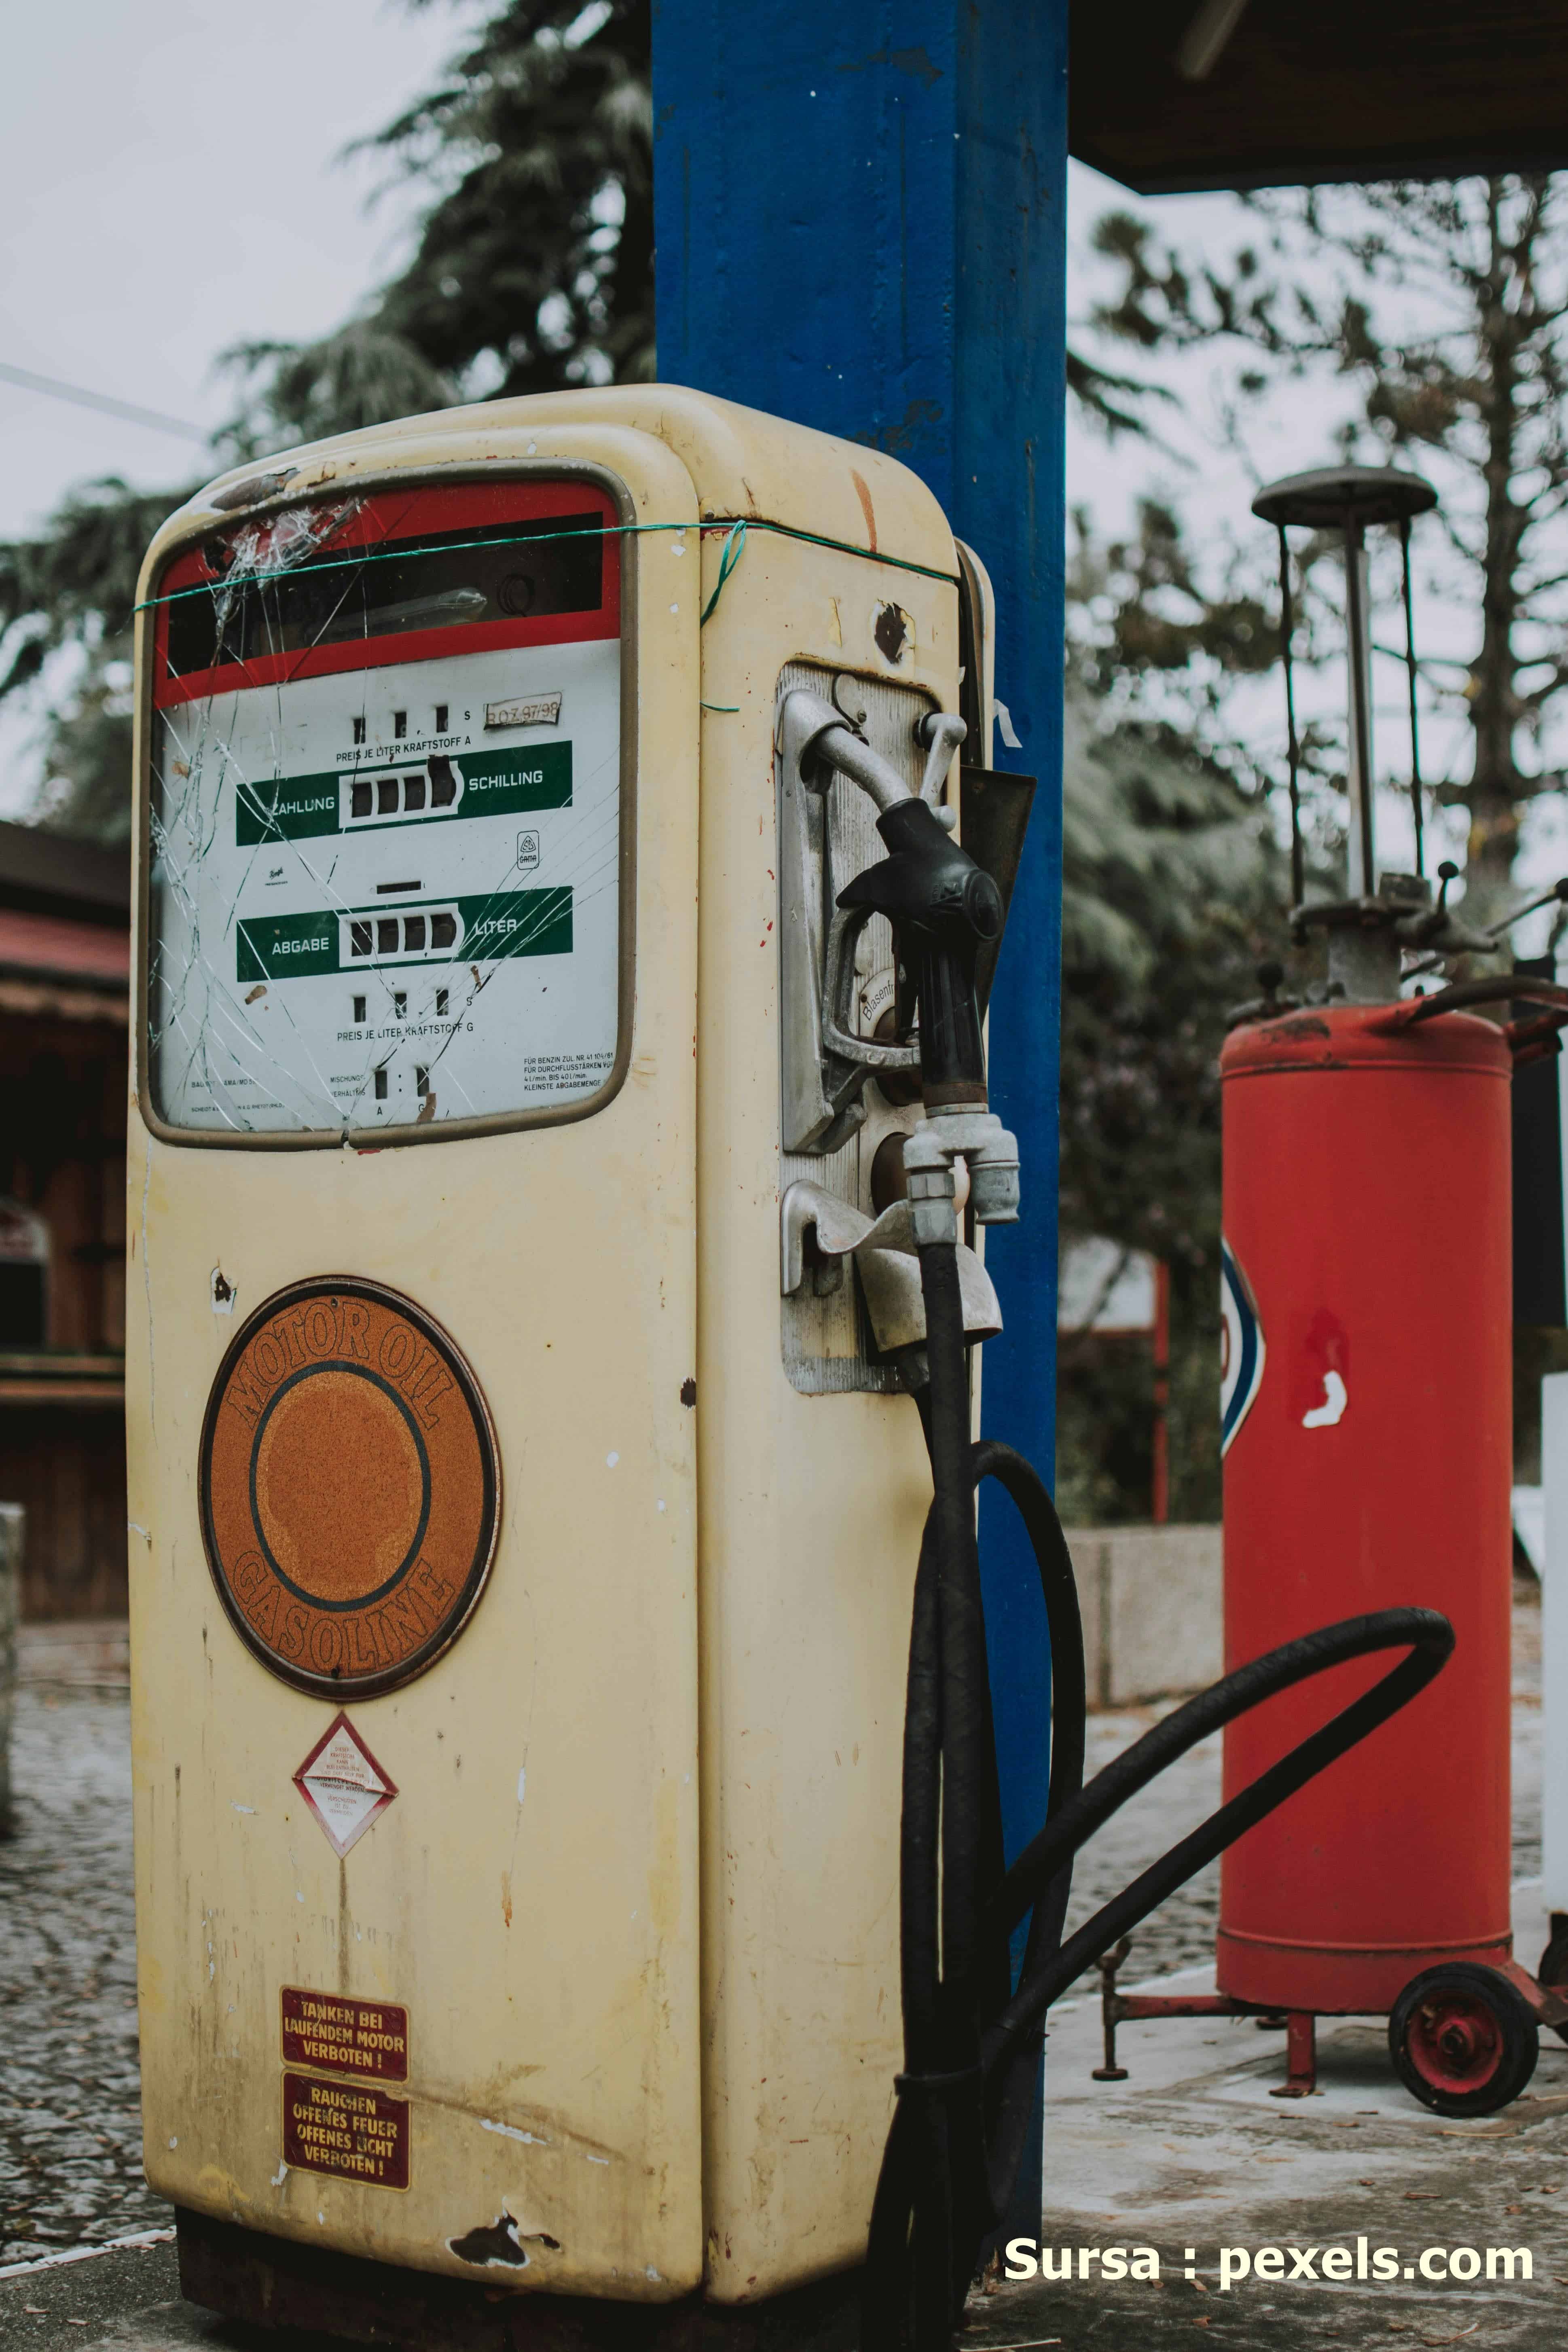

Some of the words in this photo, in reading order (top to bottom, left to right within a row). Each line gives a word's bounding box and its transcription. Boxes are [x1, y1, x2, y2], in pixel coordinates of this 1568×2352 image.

[523, 701, 558, 720] 97/98
[336, 751, 361, 762] PREIS
[364, 749, 373, 758] JE
[377, 745, 400, 756] LITER
[404, 737, 461, 753] KRAFTSTOFF
[465, 736, 471, 745] A
[469, 771, 543, 791] SCHILLING
[475, 919, 517, 935] LITER
[272, 938, 329, 955] ABGABE
[337, 1031, 362, 1042] PREIS
[365, 1030, 374, 1039] JE
[405, 1023, 463, 1036] KRAFTSTOFF
[467, 1023, 473, 1031] G
[524, 1083, 554, 1091] KLEINSTE
[556, 1080, 601, 1089] ABGABEMENGE
[377, 1107, 383, 1116] A
[226, 1302, 370, 1431] MOTOR
[380, 1325, 457, 1431] OIL
[233, 1551, 455, 1673] GASOLINE
[301, 2001, 355, 2025] TANKEN
[360, 2011, 382, 2030] BEI
[285, 2017, 353, 2045] LAUFENDEM
[357, 2030, 404, 2053] MOTOR
[311, 2087, 376, 2115] RAUCHEN
[293, 2103, 347, 2129] OFFENES
[353, 2117, 398, 2138] FEUER
[297, 2123, 351, 2149] OFFENES
